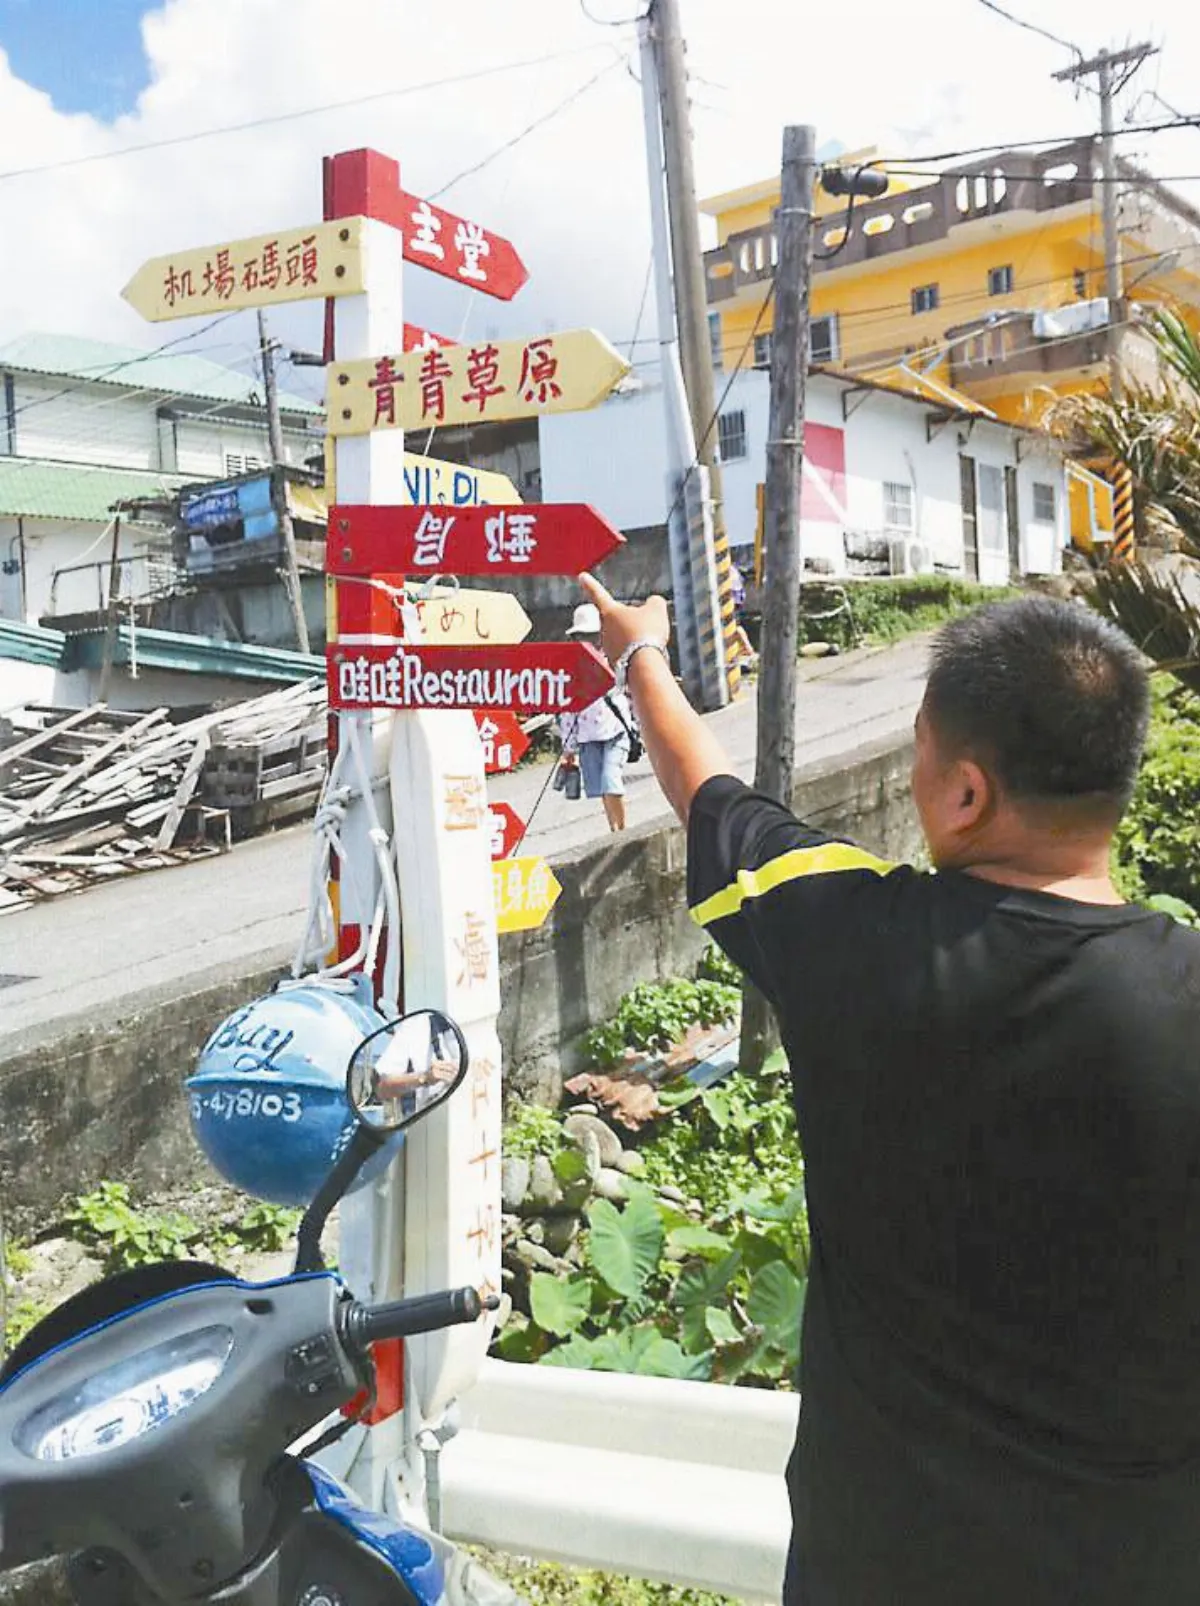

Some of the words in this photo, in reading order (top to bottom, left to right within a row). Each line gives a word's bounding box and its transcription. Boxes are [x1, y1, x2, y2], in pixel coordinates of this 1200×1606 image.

[163, 234, 319, 307] 机場碼頭
[409, 201, 491, 282] 主堂
[366, 338, 564, 426] 青青草原
[412, 510, 539, 566] 郵局
